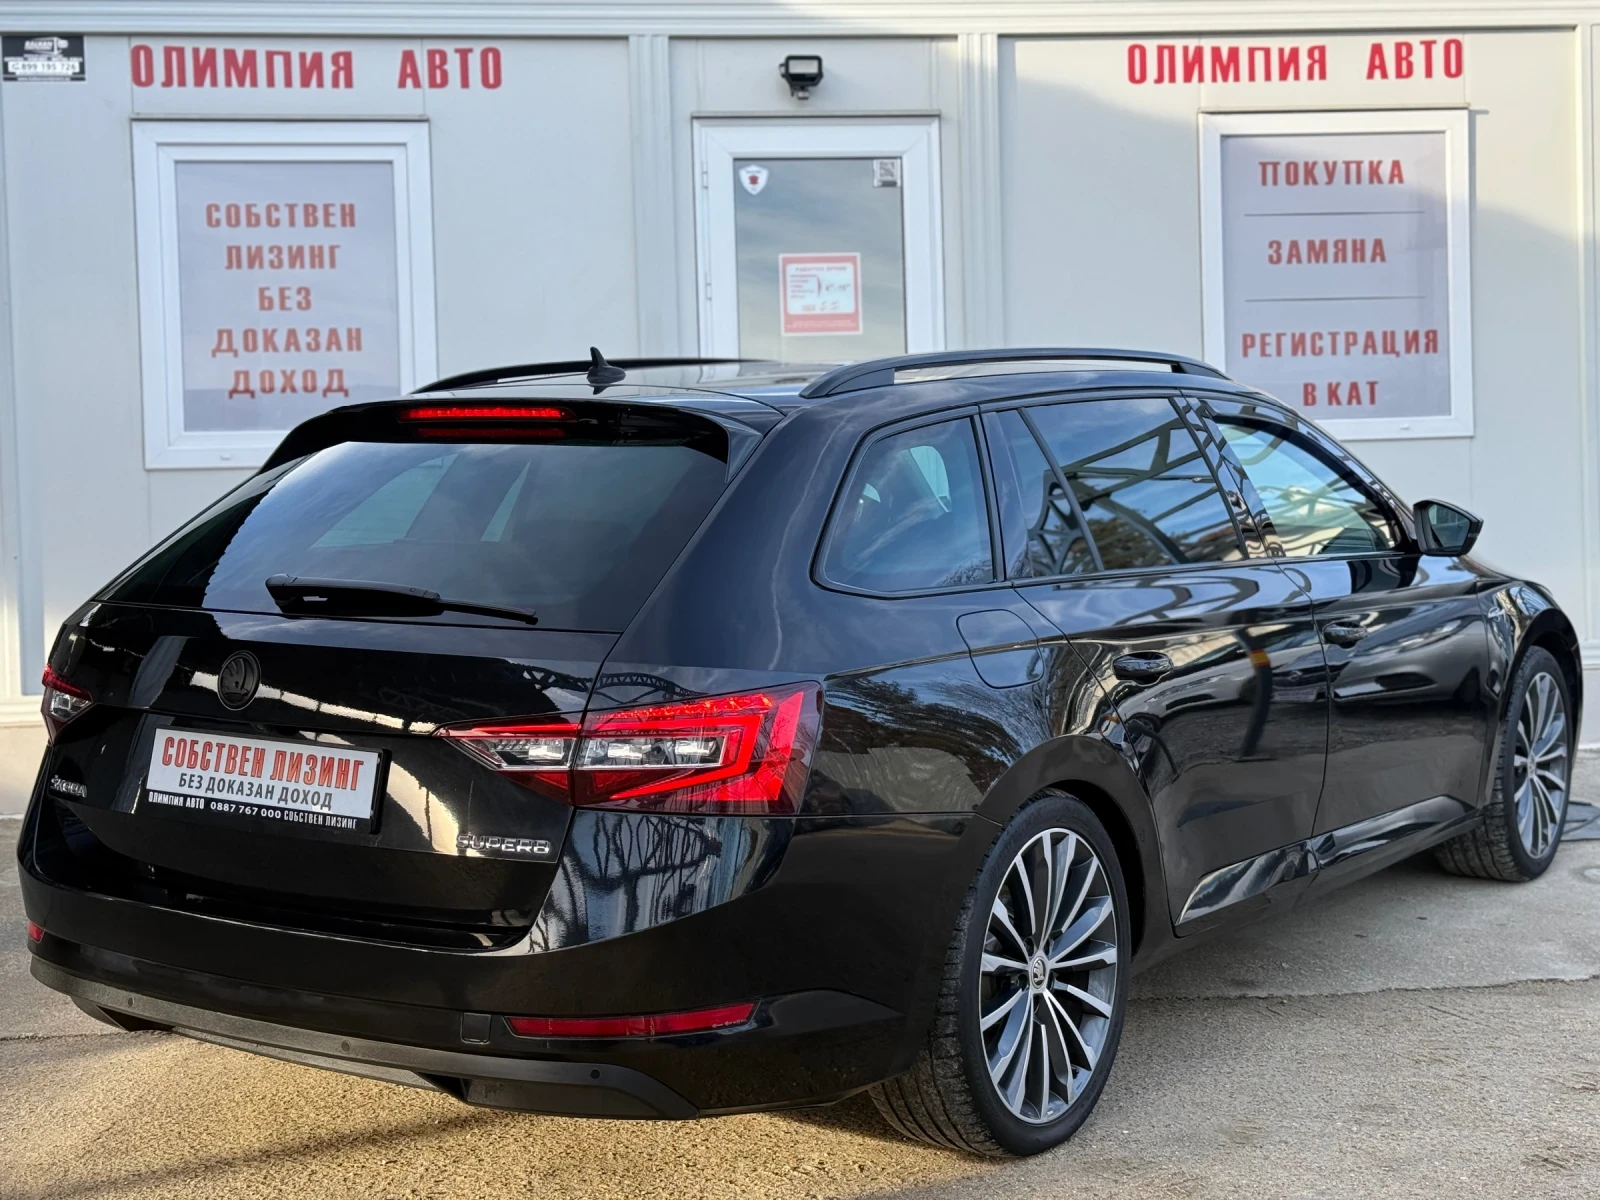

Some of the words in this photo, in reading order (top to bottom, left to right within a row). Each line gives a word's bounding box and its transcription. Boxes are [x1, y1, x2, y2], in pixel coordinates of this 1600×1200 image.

[130, 44, 354, 89] ОЛИМПИЯ
[397, 46, 503, 90] АВТО
[1127, 43, 1327, 85] ОЛИМПИЯ
[1366, 38, 1464, 81] АВТО
[1258, 159, 1405, 187] ПОКУПКА
[205, 203, 356, 228] СОБСТВЕН
[225, 245, 341, 270] ЛИЗИНГ
[1267, 238, 1387, 265] ЗАМЯНА
[258, 286, 312, 311] БЕЗ
[211, 327, 363, 358] ДОКАЗАН
[1242, 329, 1439, 358] РЕГИСТРАЦИЯ
[228, 369, 349, 399] ДОХОД
[1303, 383, 1316, 407] В
[1326, 380, 1379, 406] КАТ
[162, 736, 266, 778] СОБСТВЕН
[269, 749, 365, 792] ЛИЗИНГ
[178, 772, 204, 790] БЕЗ
[205, 776, 275, 801] ДОКАЗАН
[277, 786, 333, 811] ДОХОД
[148, 791, 184, 807] ОЛИМПИЯ
[185, 797, 205, 810] АВТО
[210, 801, 236, 812] 0887
[238, 805, 258, 816] 767
[260, 808, 282, 819] 000
[283, 810, 324, 826] СОБСТВЕН
[324, 815, 358, 830] ЛИЗИНГ
[456, 833, 551, 854] SUPERB
